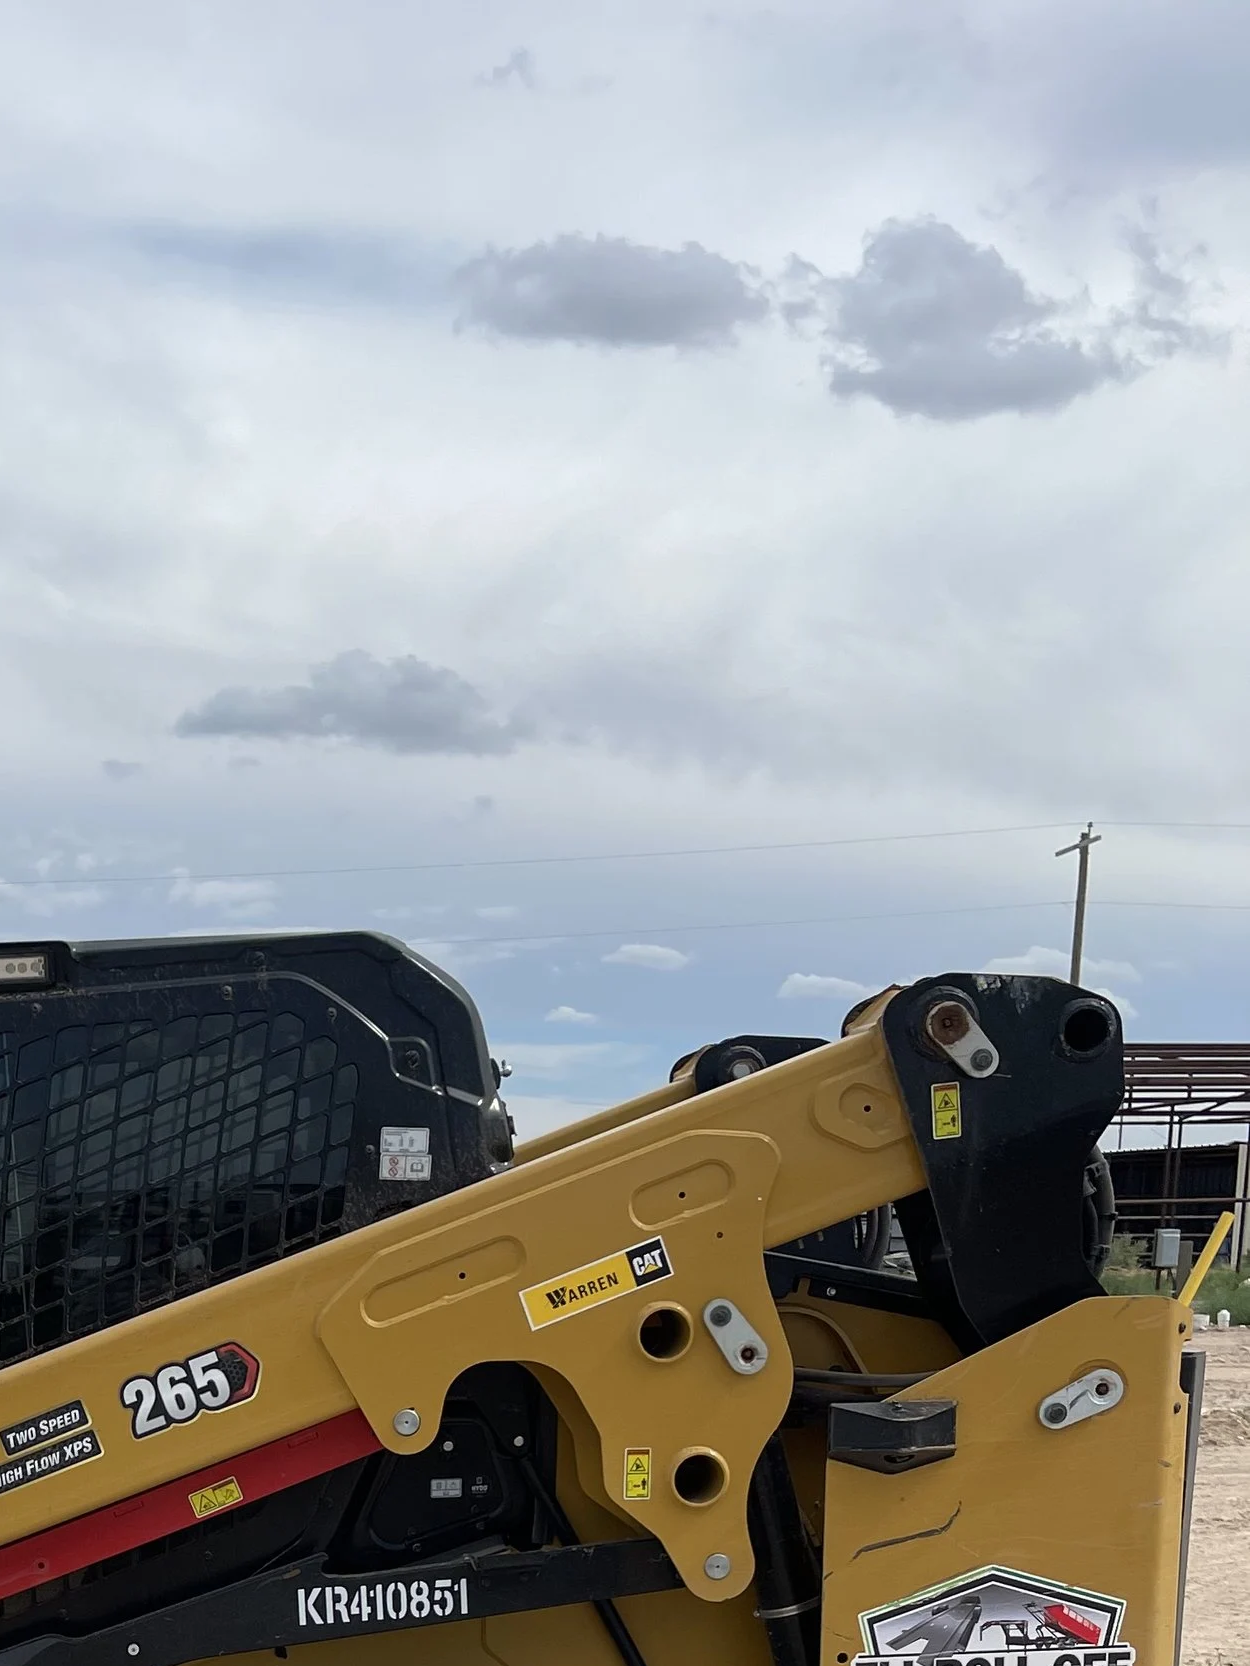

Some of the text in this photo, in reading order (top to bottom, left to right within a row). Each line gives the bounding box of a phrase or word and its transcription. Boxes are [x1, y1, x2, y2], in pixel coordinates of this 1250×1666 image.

[545, 1249, 662, 1309] WARREN CAT
[123, 1351, 231, 1436] 265
[6, 1409, 81, 1449] TWO SPEED
[25, 1453, 61, 1477] FLOW
[64, 1437, 93, 1462] XPS
[297, 1578, 469, 1626] KR410851
